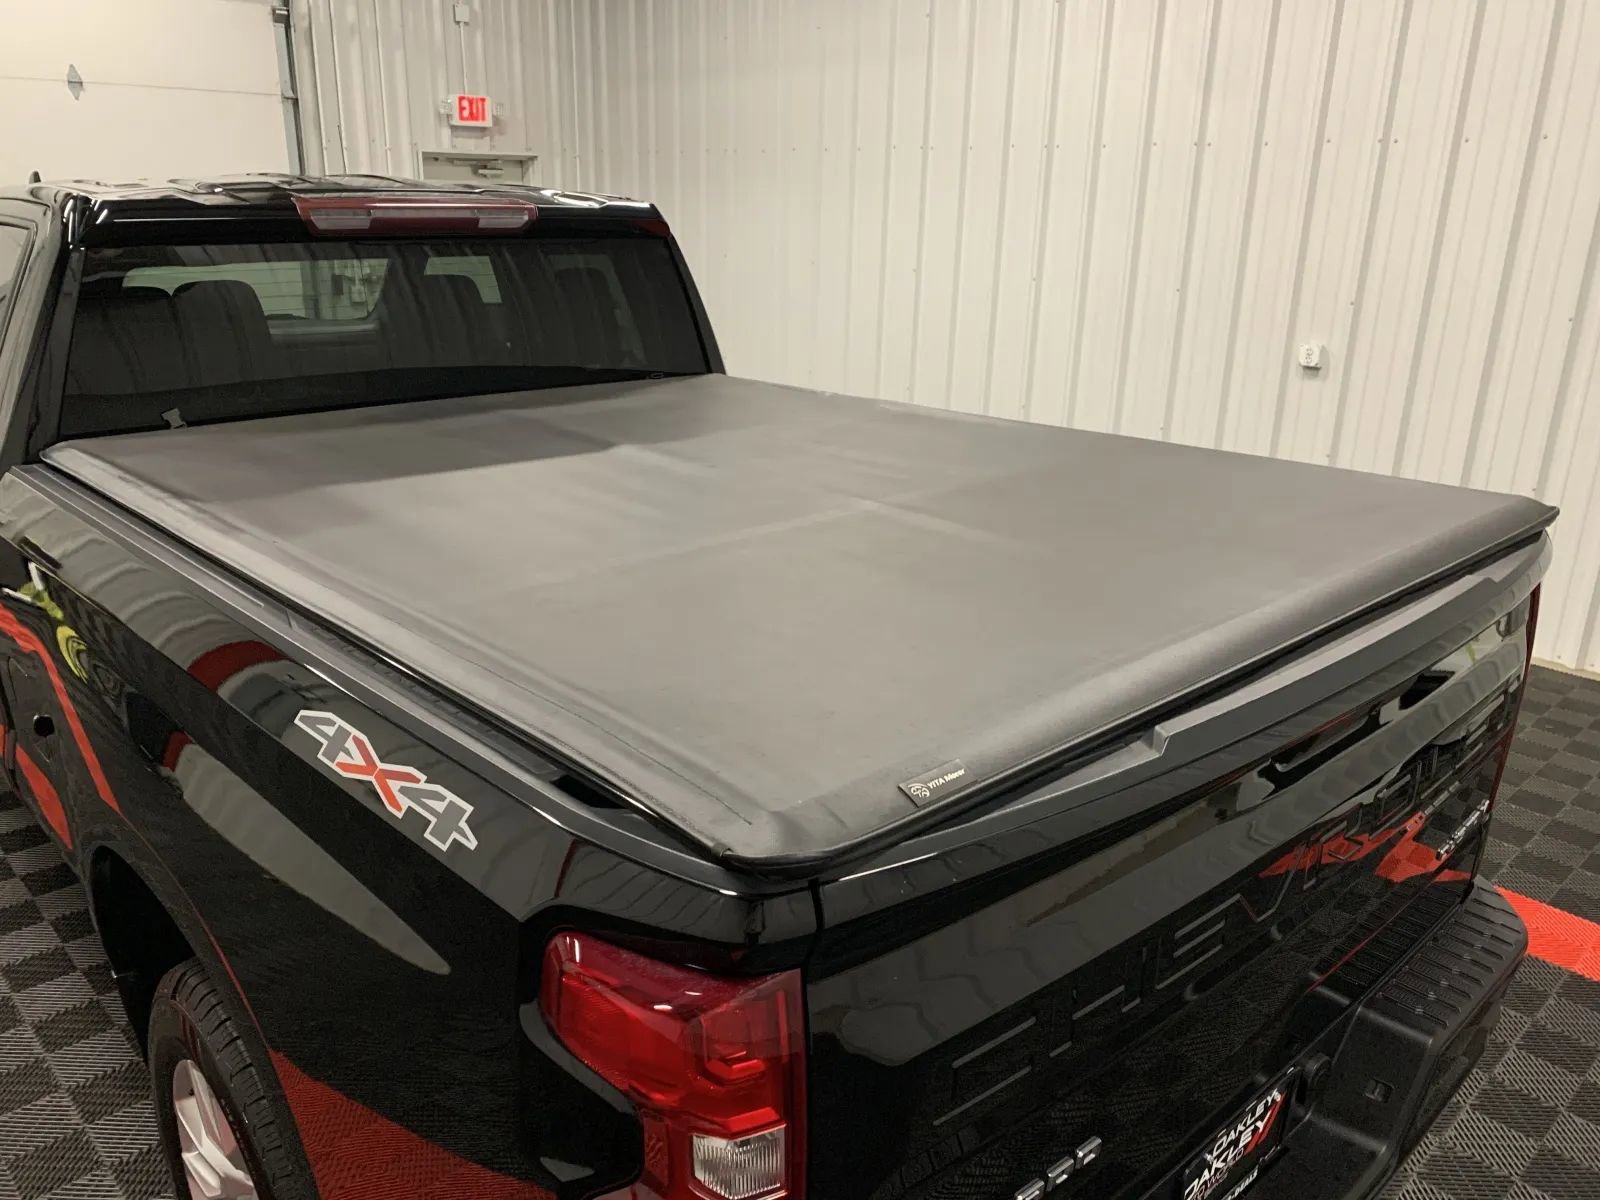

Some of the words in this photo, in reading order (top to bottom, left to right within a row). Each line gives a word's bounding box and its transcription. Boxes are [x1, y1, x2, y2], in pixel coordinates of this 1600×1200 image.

[458, 96, 487, 122] EXIT
[1184, 1110, 1272, 1200] OAKLEY
[1212, 1089, 1278, 1158] OAKLEY
